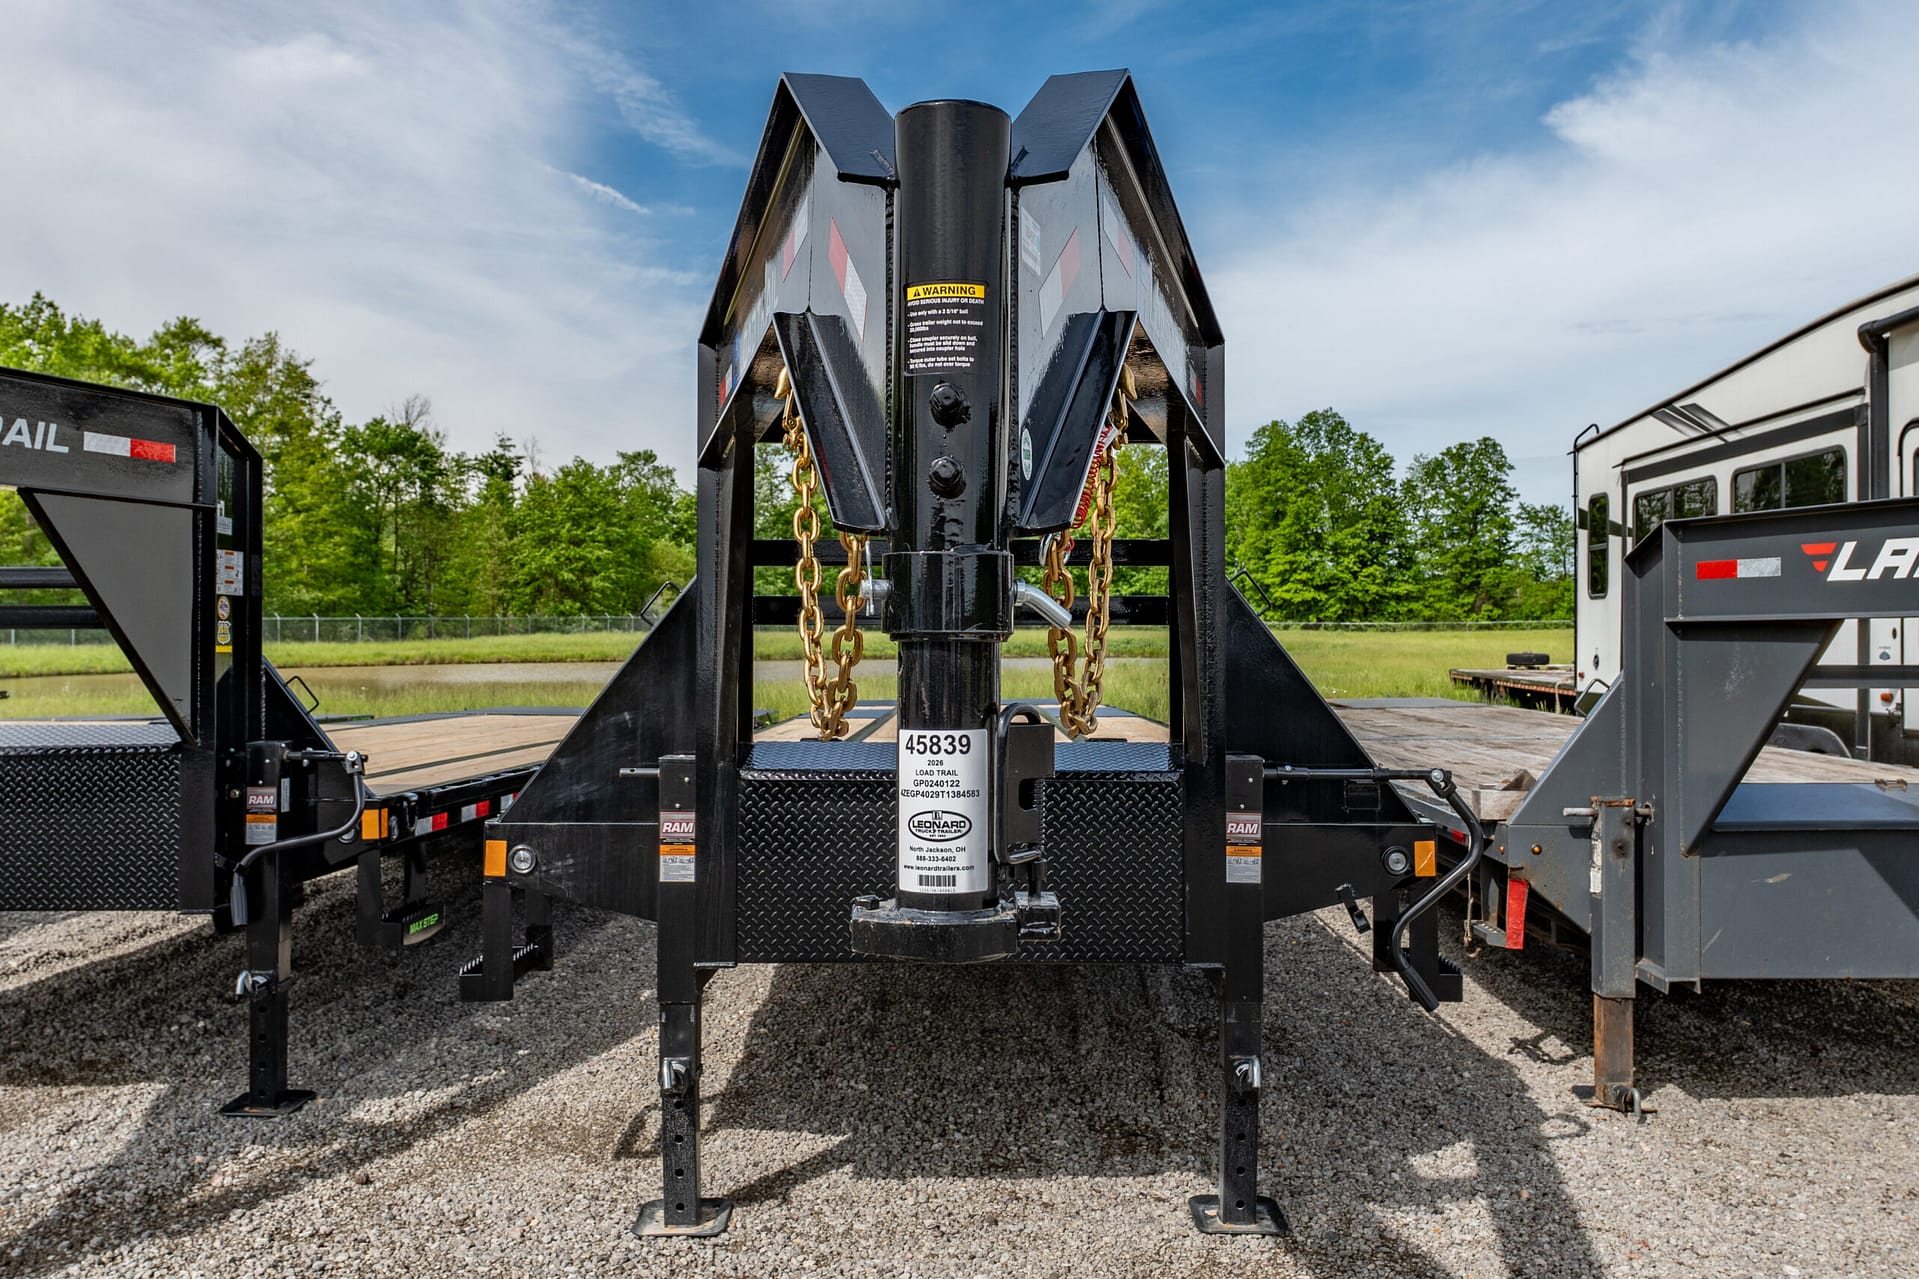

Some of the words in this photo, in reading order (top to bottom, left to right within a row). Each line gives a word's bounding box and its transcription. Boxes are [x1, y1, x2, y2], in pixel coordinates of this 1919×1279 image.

[922, 286, 976, 296] WARNING
[968, 297, 985, 305] DEATH
[0, 416, 69, 454] AIL
[1826, 537, 1919, 581] LA
[905, 734, 971, 755] 45839
[915, 769, 935, 777] LOAD
[936, 769, 958, 777] TRAIL
[913, 779, 960, 788] GP0240122
[248, 795, 274, 805] RAM
[662, 822, 694, 833] RAM
[912, 820, 966, 829] LEONARD
[1227, 823, 1258, 834] RAM
[916, 855, 957, 863] 888-333-6402
